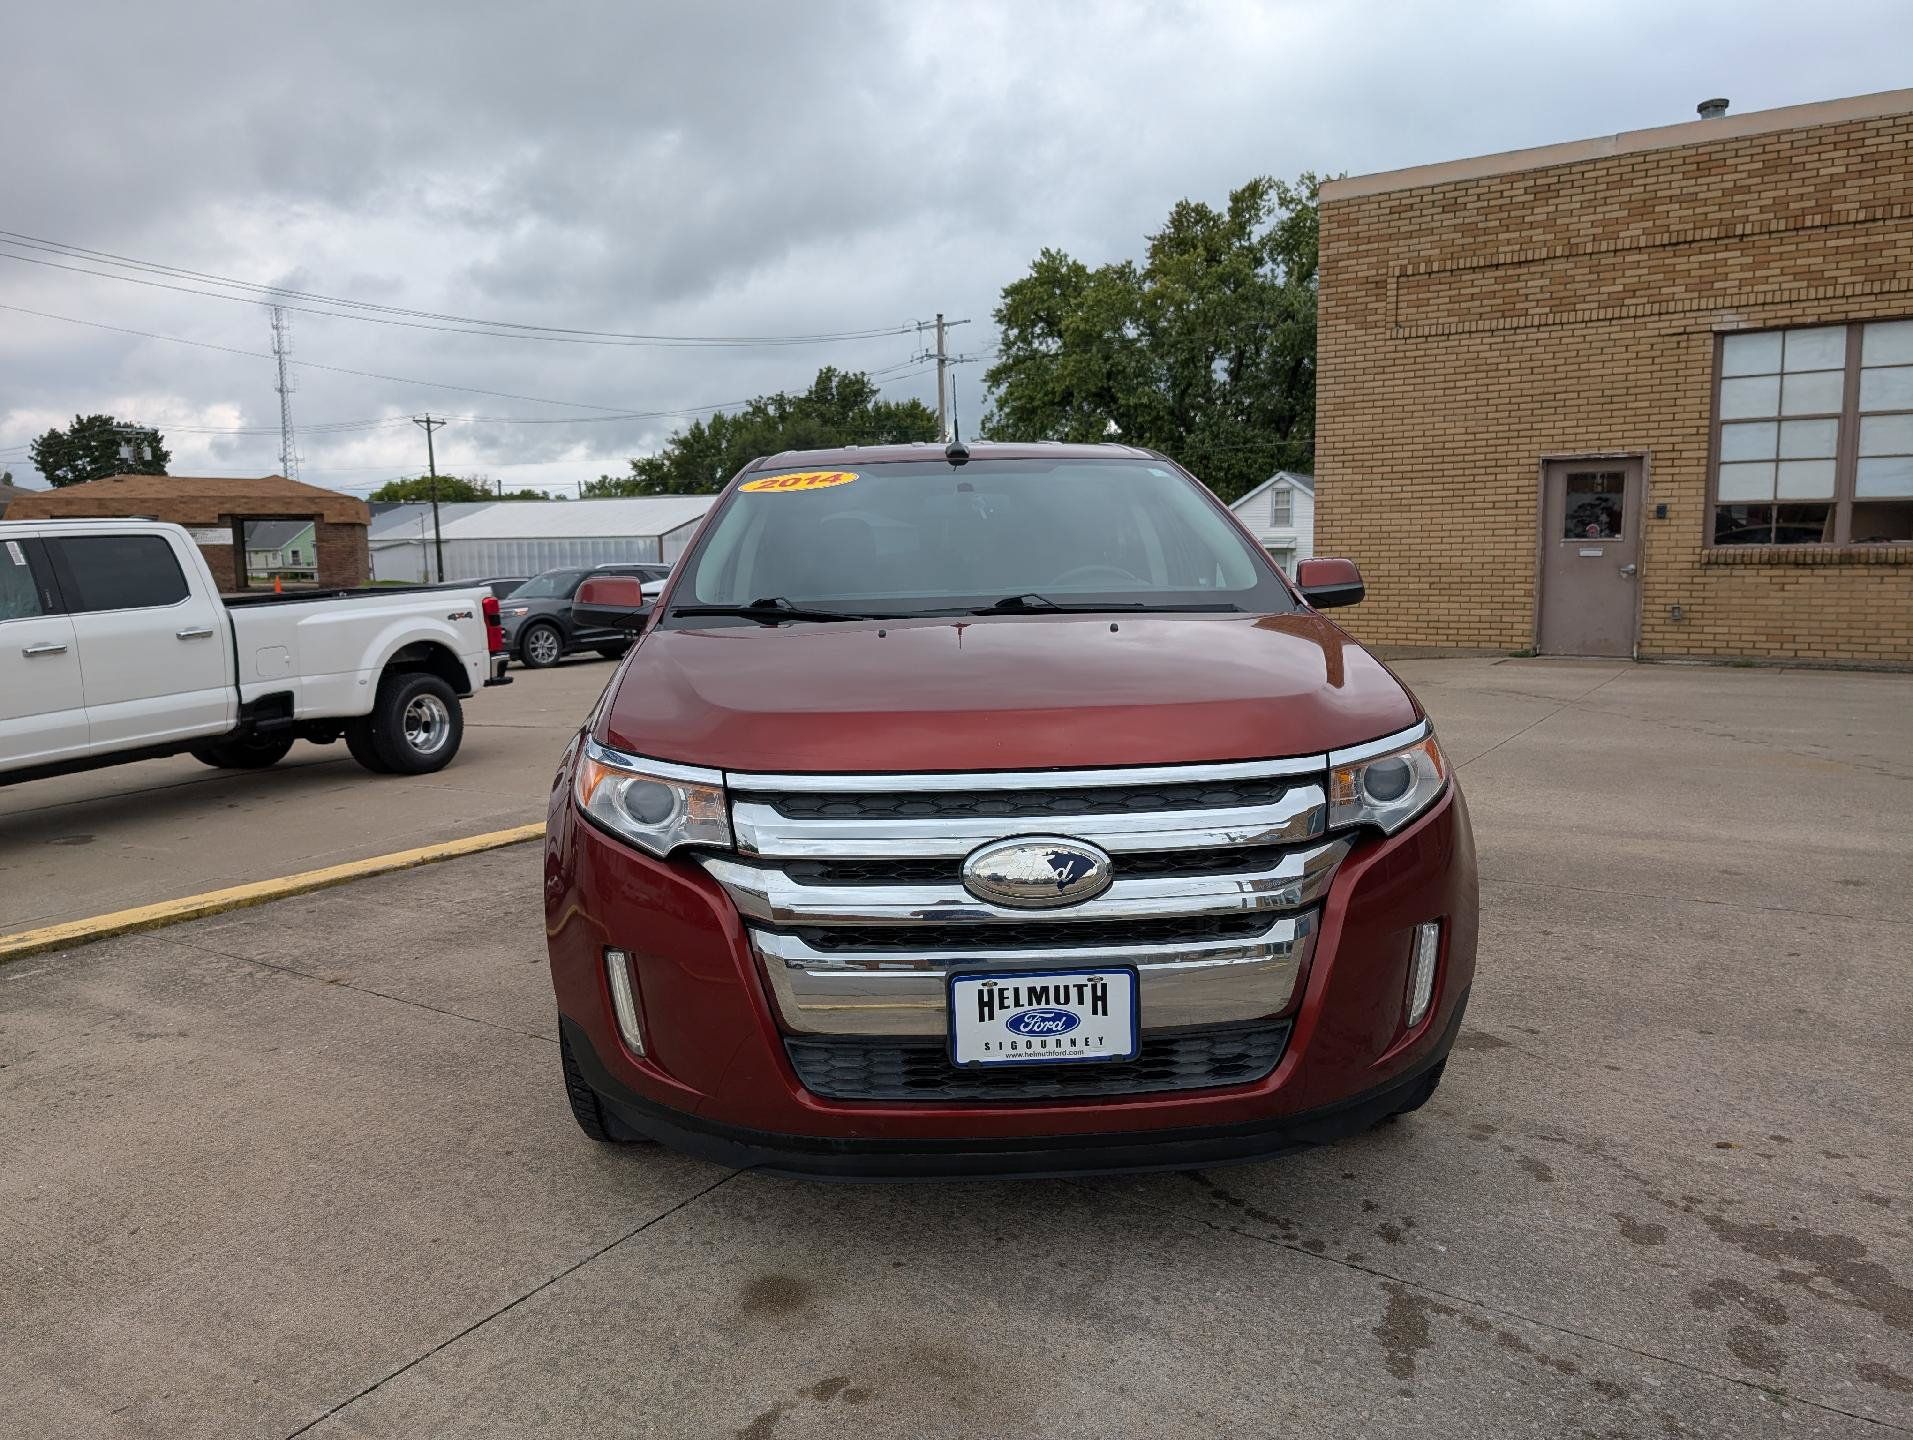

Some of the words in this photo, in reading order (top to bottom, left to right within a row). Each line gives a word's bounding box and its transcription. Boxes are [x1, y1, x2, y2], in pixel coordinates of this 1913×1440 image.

[752, 473, 843, 490] 2014
[977, 981, 1108, 1022] HELMUTH
[1019, 1012, 1066, 1032] Ford
[1005, 1049, 1084, 1059] www.helmuthford.com
